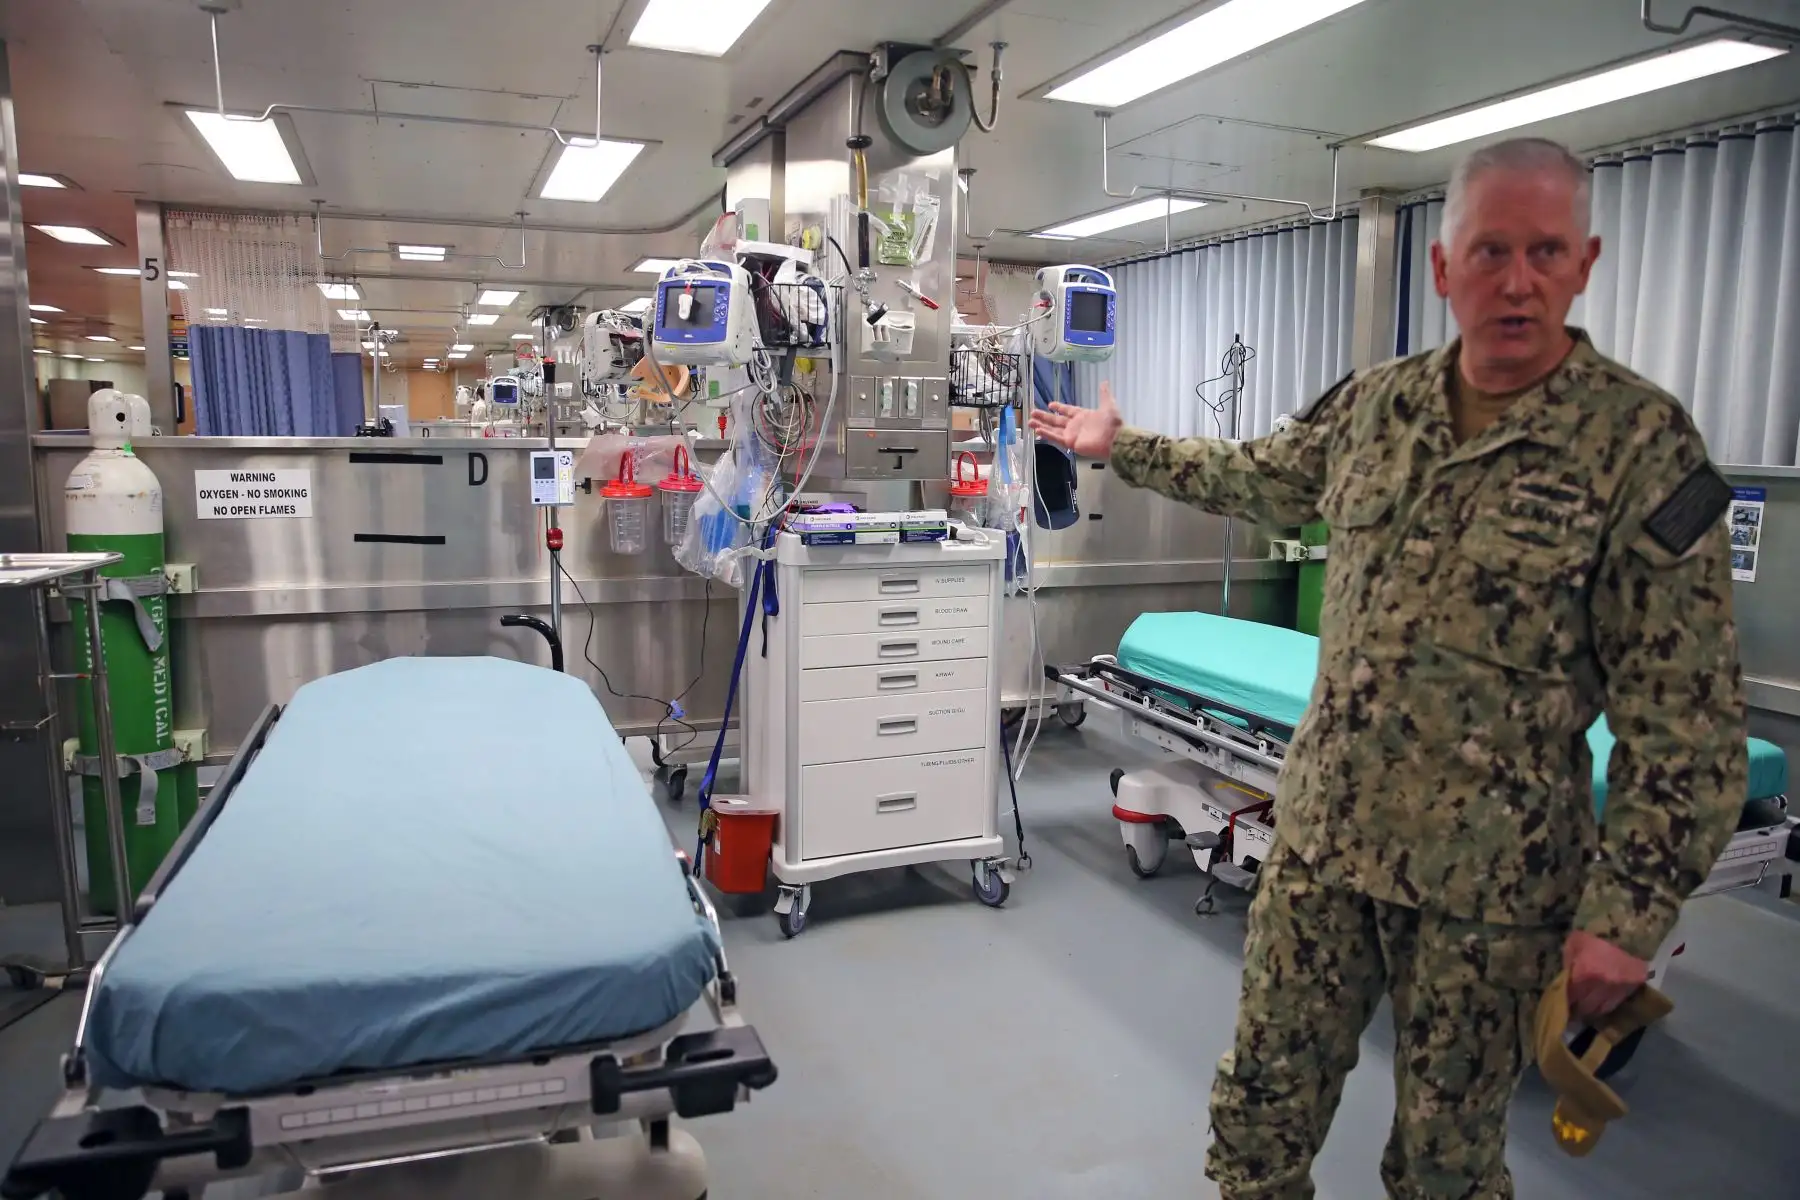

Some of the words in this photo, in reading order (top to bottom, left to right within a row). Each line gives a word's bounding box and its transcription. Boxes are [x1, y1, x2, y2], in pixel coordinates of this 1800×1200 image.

[145, 258, 159, 281] 5
[230, 472, 276, 482] WARNING
[468, 452, 489, 486] D
[199, 489, 239, 499] OXYGEN
[247, 489, 261, 498] NO
[263, 488, 308, 498] SMOKING
[213, 506, 228, 515] NO
[230, 505, 256, 515] OPEN
[258, 504, 296, 514] FLAMES
[153, 655, 168, 747] MEDICAL
